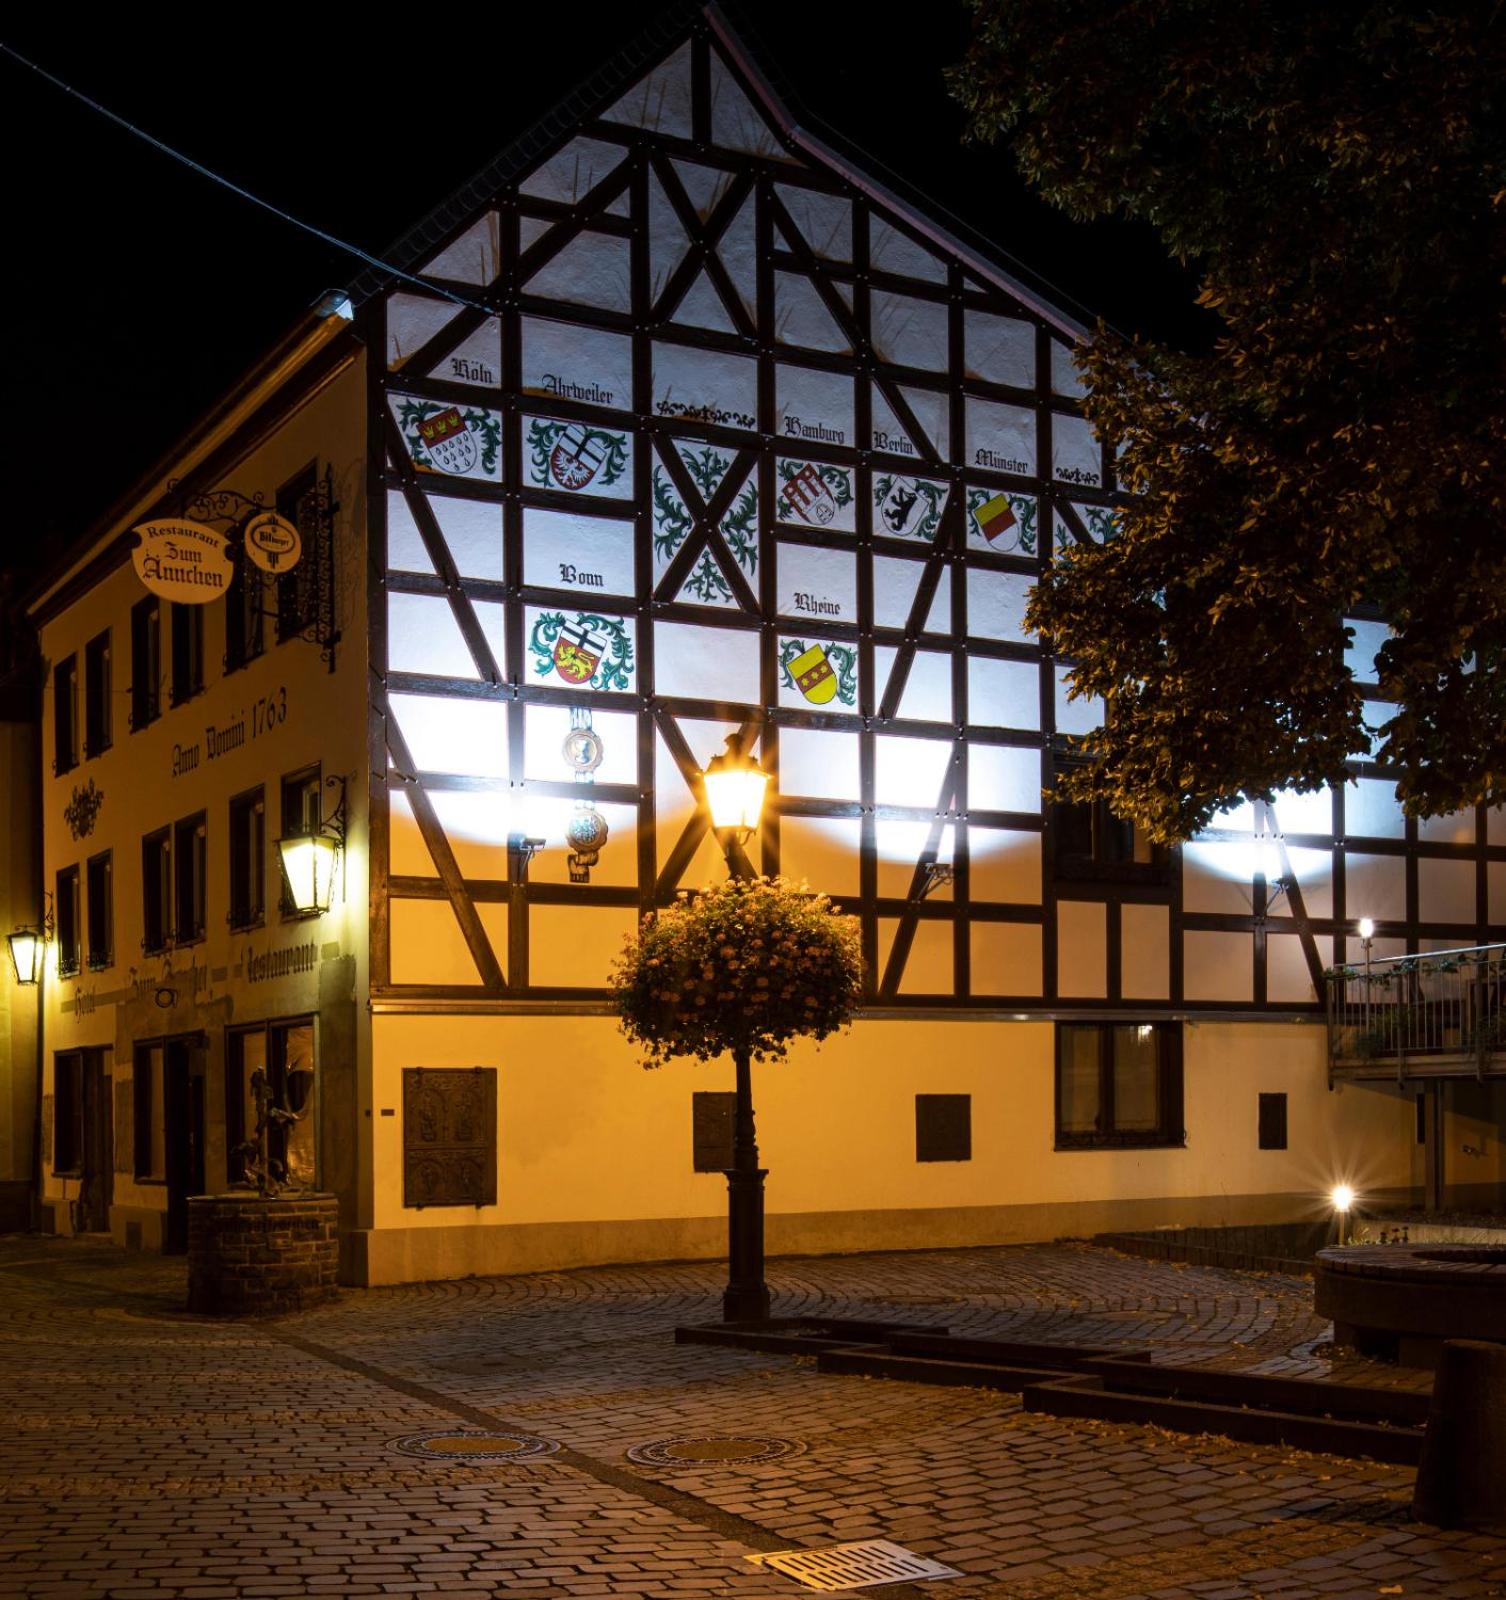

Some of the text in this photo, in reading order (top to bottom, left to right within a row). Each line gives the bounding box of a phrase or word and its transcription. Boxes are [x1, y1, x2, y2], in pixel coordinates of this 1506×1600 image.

[451, 357, 493, 384] Köln
[542, 374, 613, 405] Ahrweiler
[784, 416, 844, 444] Hamburg
[873, 431, 913, 455] Berlin
[975, 449, 1028, 475] Münster
[147, 526, 220, 548] Restaurant
[164, 541, 203, 563] Zum
[142, 550, 224, 588] Ännchen
[559, 563, 604, 587] Bonn
[794, 592, 840, 616] Rheine
[172, 687, 287, 777] Anno Domini 1763
